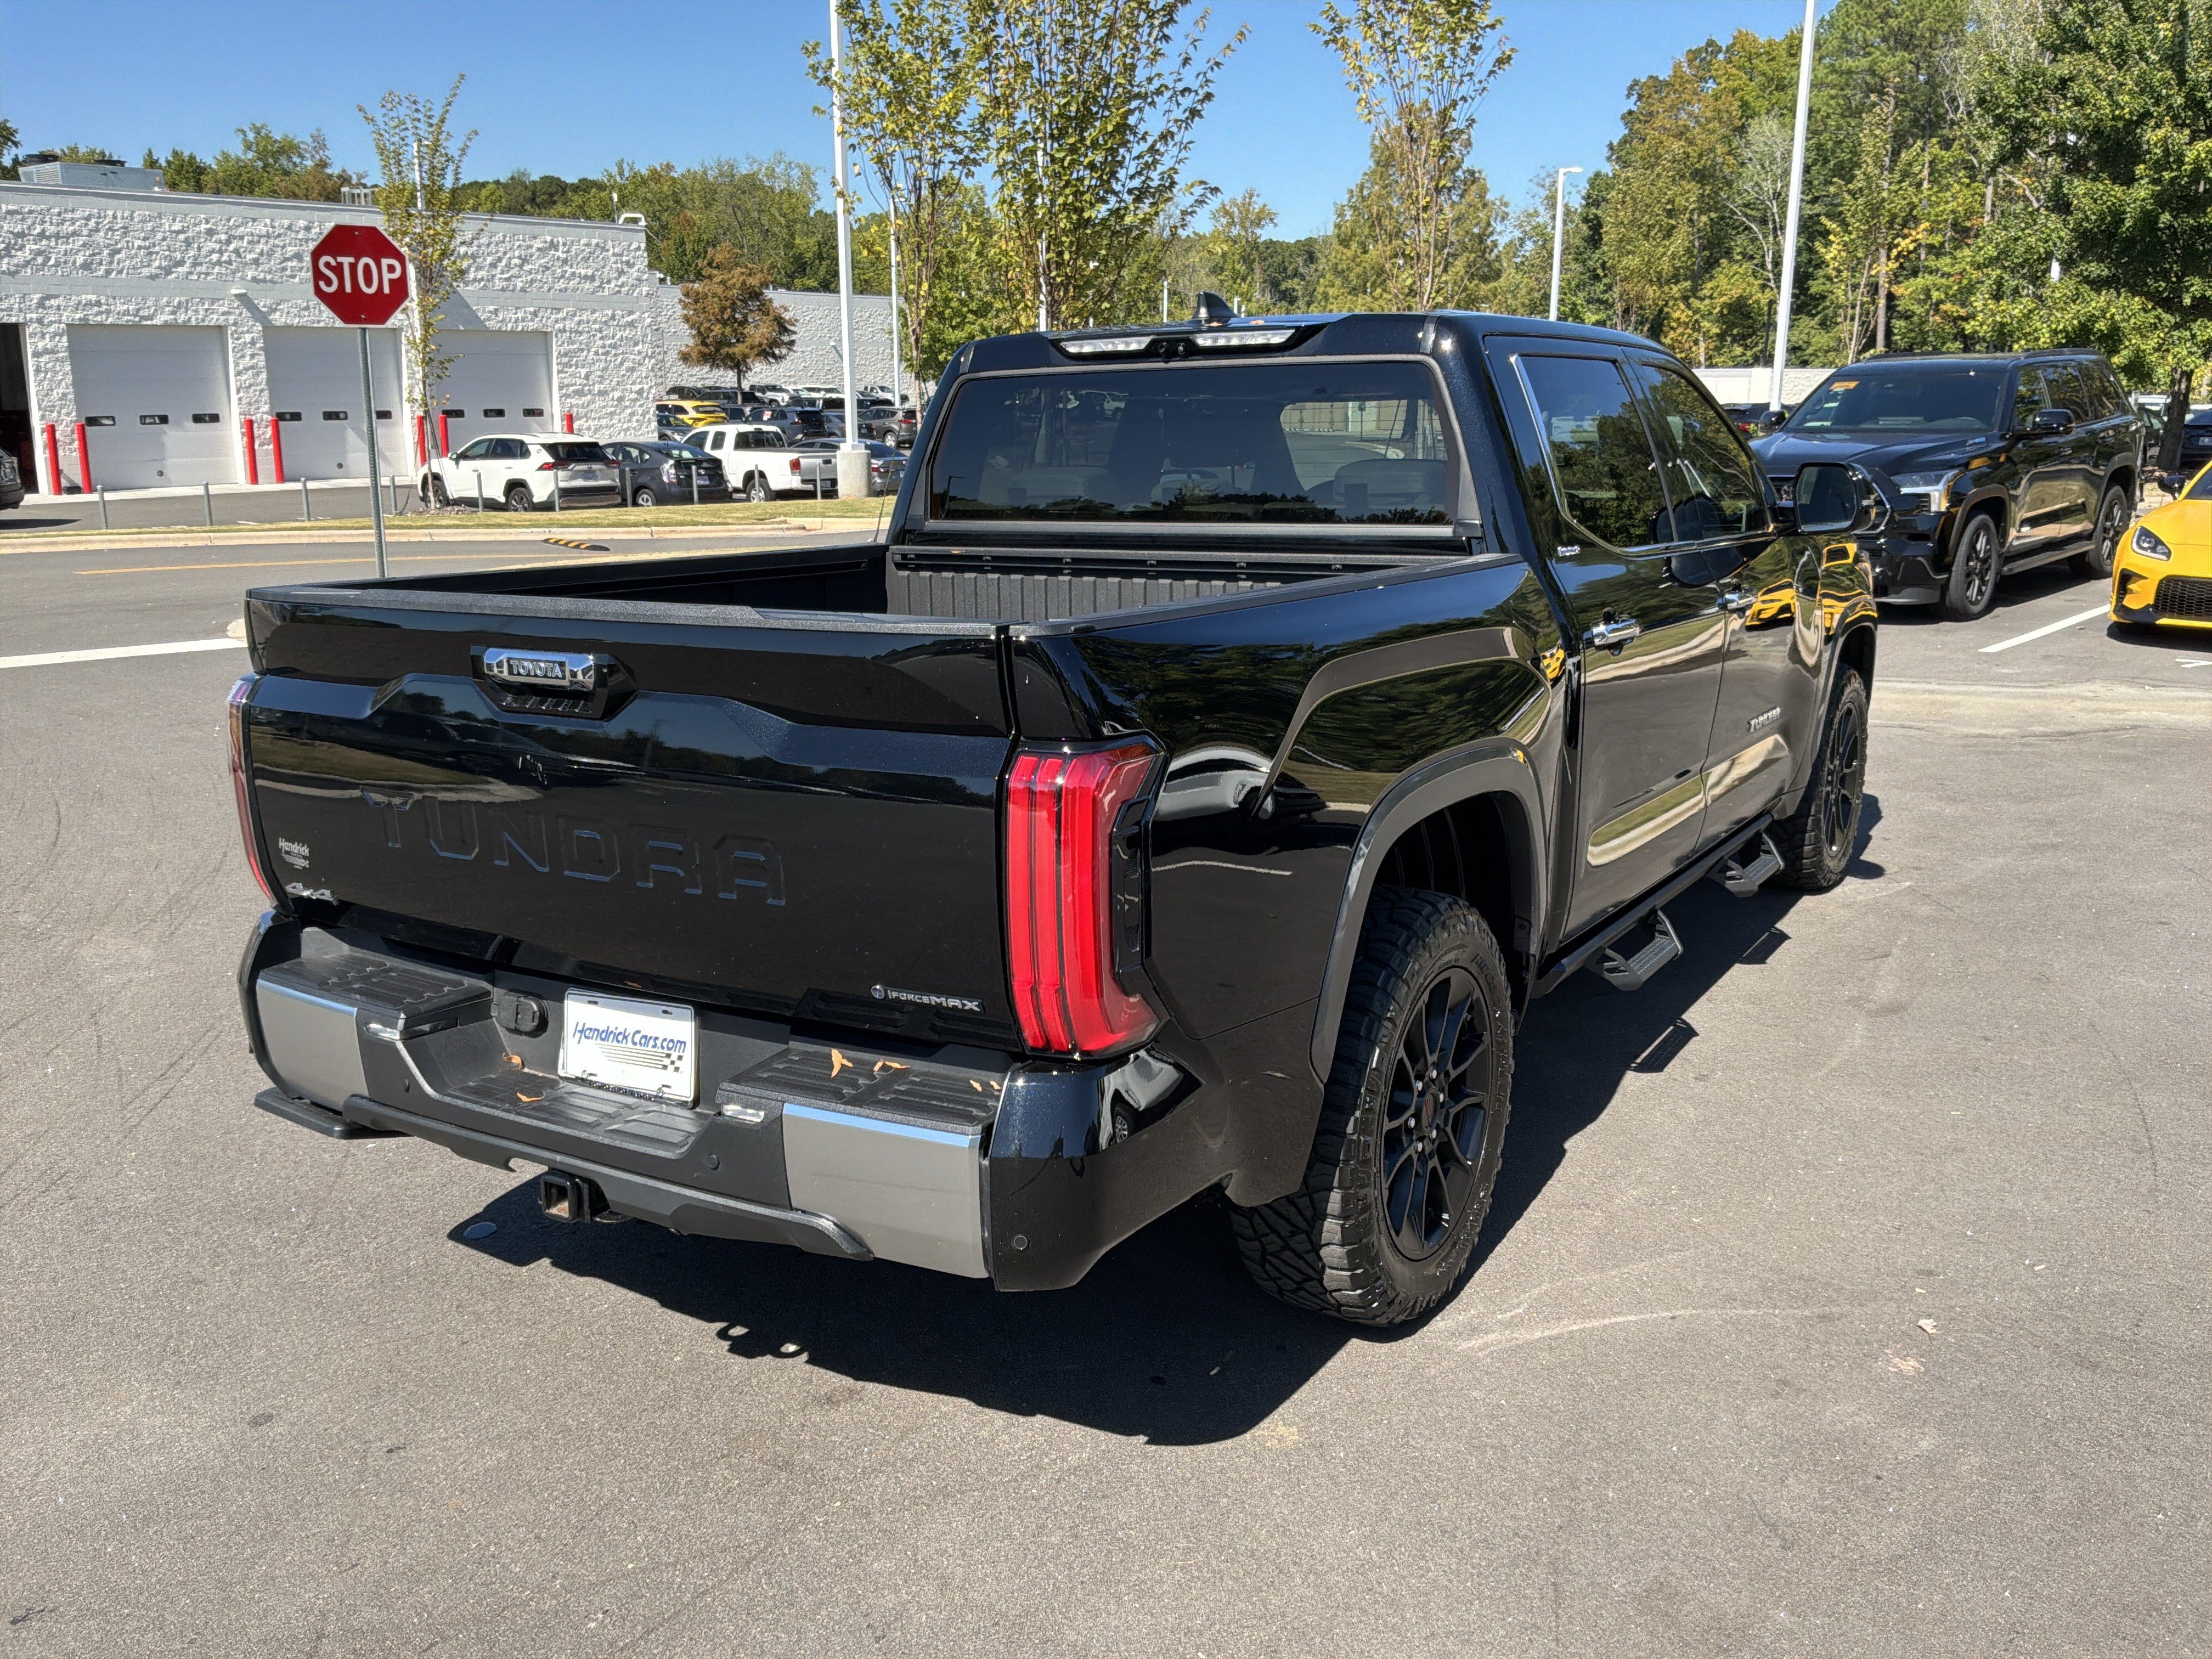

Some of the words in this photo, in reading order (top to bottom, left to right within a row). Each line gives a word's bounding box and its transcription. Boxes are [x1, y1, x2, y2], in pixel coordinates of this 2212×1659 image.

[318, 255, 402, 294] STOP
[510, 661, 563, 678] TOYOTA
[279, 837, 309, 856] Hendrick
[360, 786, 786, 906] TUNDRA
